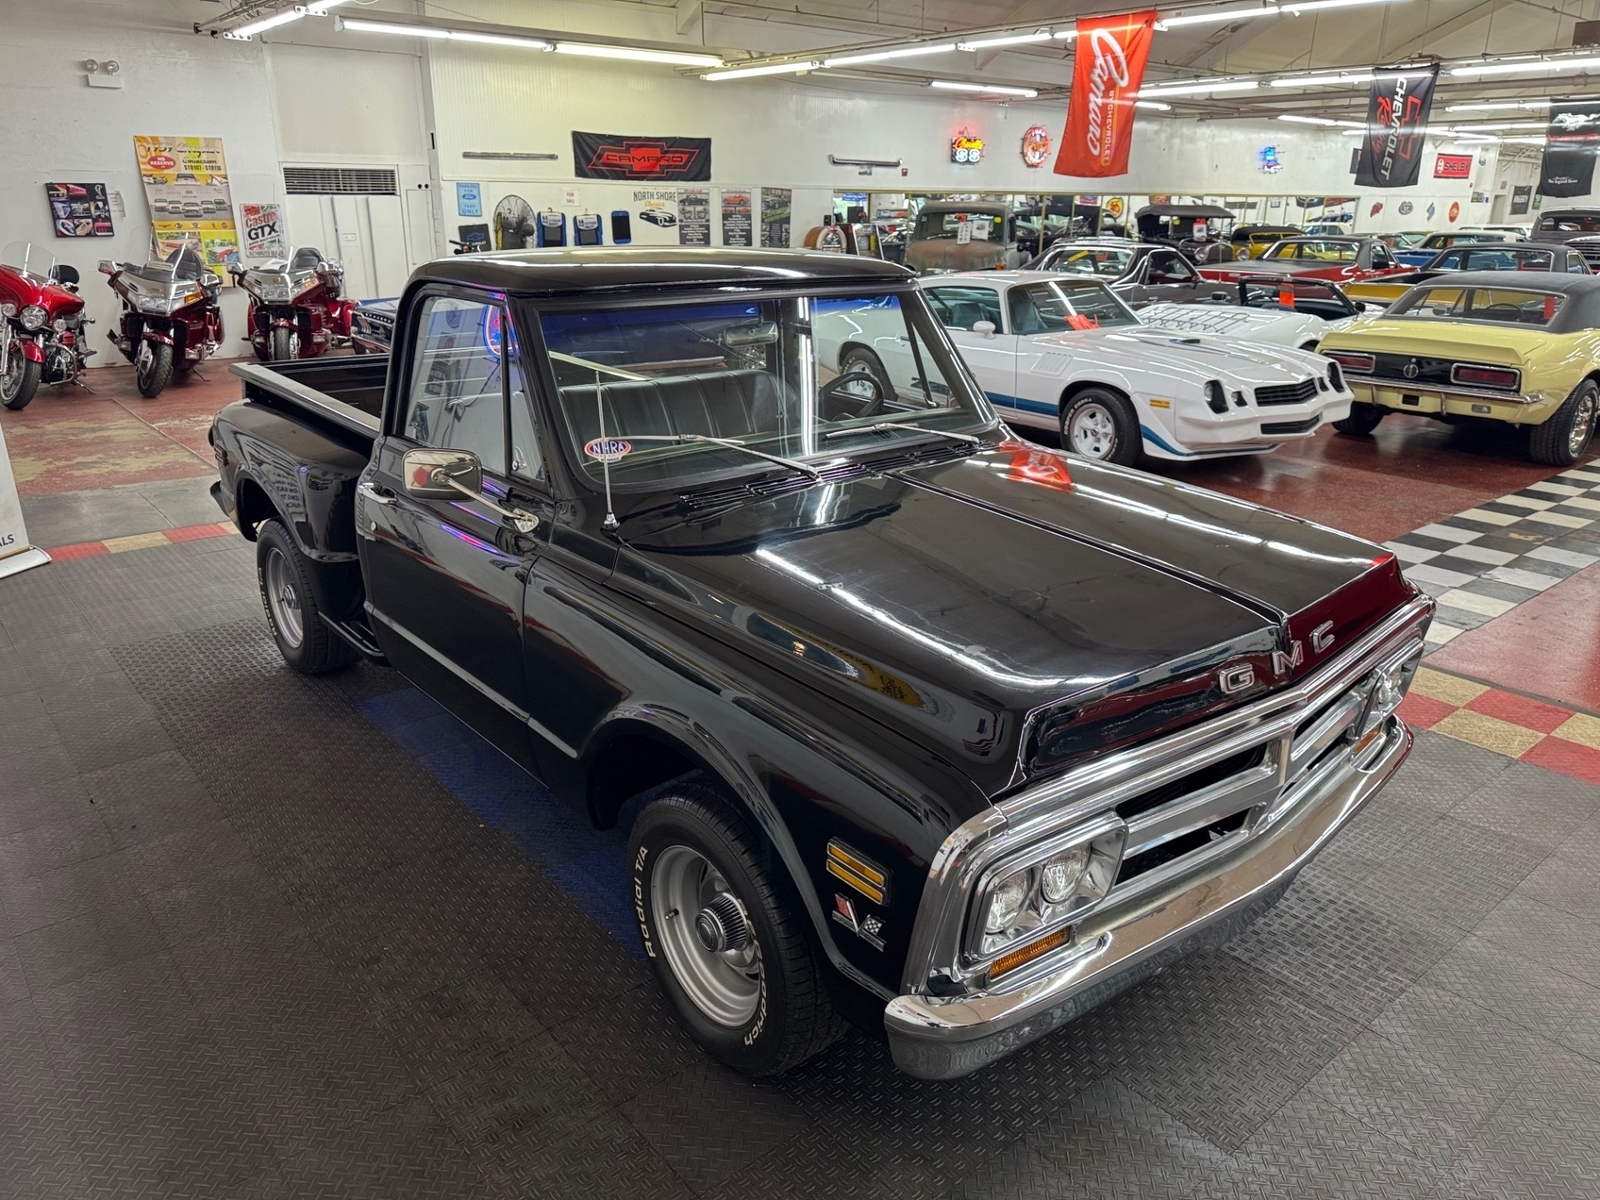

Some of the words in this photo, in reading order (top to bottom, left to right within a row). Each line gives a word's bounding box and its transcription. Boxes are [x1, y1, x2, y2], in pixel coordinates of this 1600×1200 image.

[1087, 28, 1129, 156] Camaro
[1104, 104, 1114, 161] CHEVROLET
[1380, 77, 1408, 180] CHEVROLET
[606, 154, 683, 163] CAMARO
[1444, 161, 1469, 171] SHELBY
[633, 191, 654, 202] NORTH
[656, 191, 677, 202] SHORE
[246, 212, 277, 228] Castro
[247, 221, 279, 241] GTX
[592, 440, 624, 455] NHRA
[1220, 620, 1335, 694] GMC
[634, 846, 649, 873] T/A
[634, 877, 657, 958] Radial
